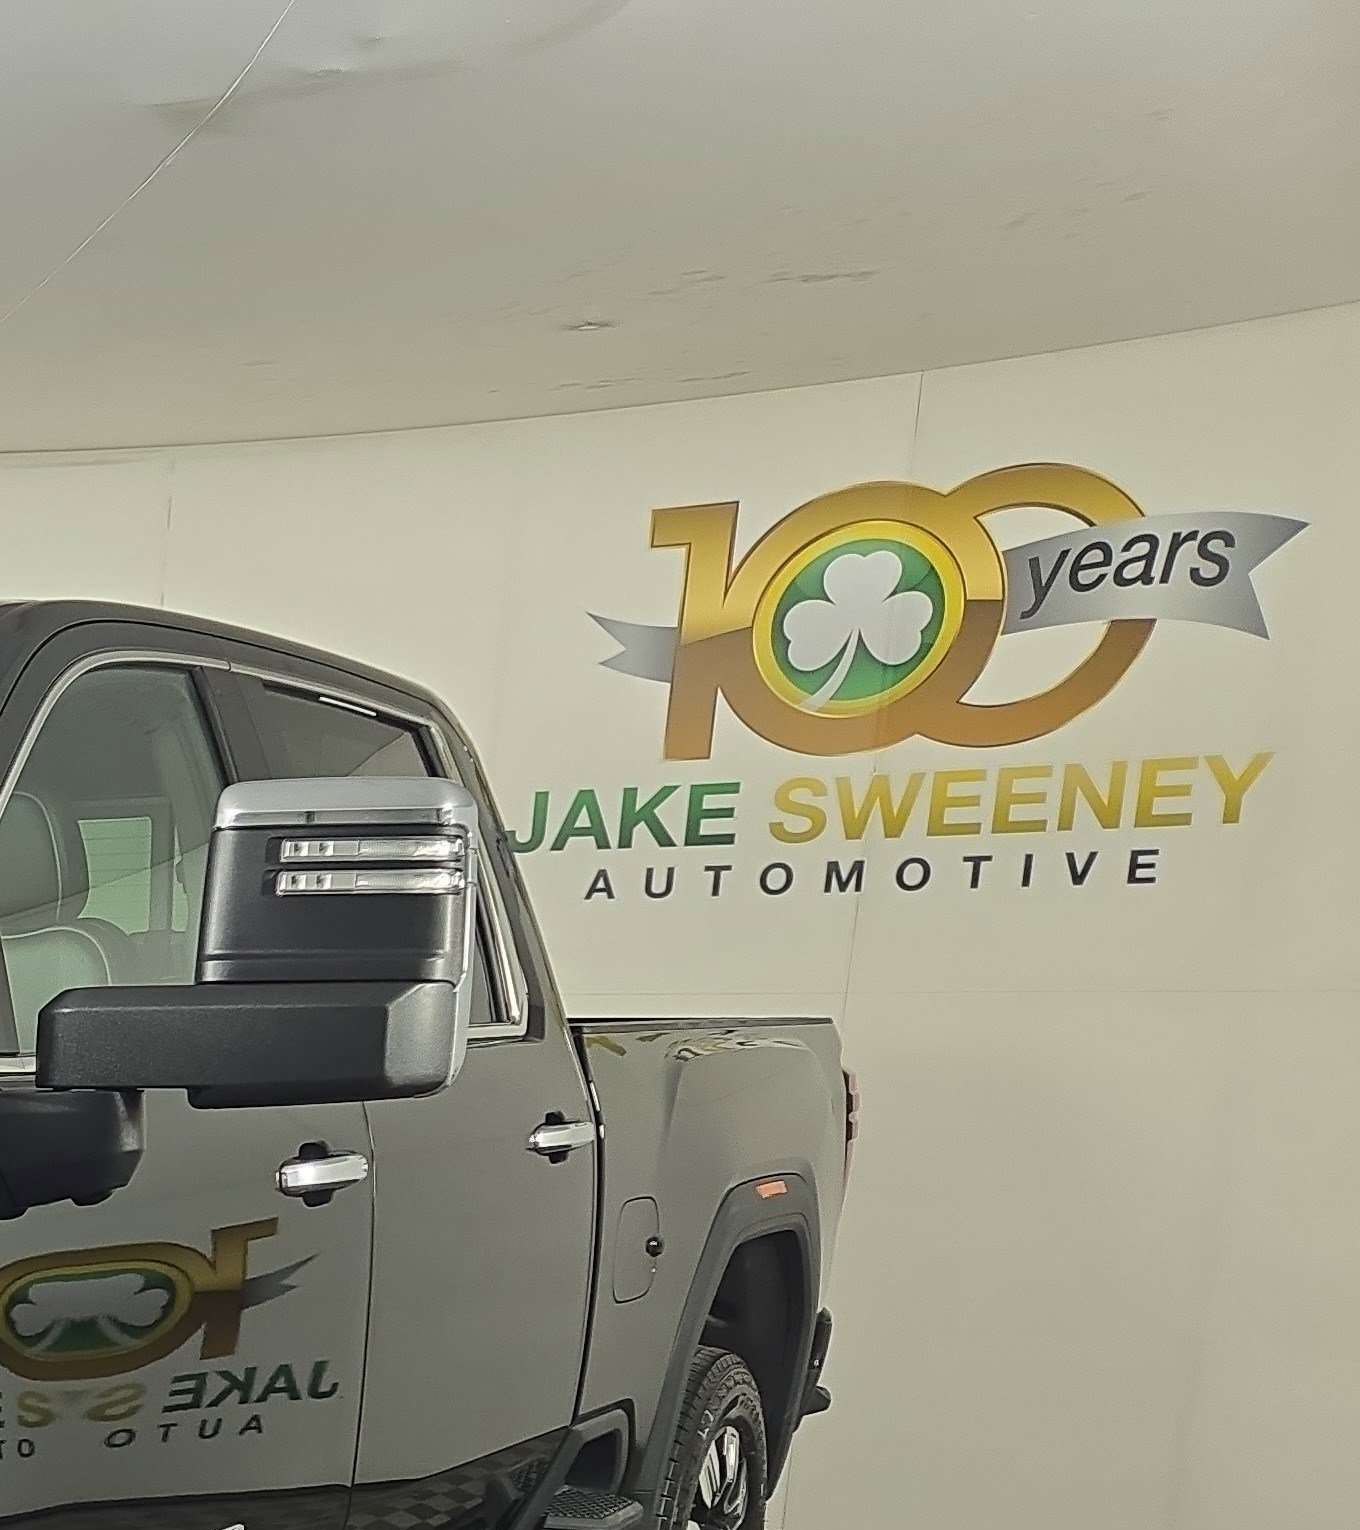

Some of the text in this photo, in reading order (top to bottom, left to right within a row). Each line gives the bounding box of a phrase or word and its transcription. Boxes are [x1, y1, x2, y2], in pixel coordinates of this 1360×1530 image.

[1019, 528, 1235, 619] years
[504, 751, 1275, 853] JAKE SWEENEY
[584, 849, 1161, 901] AUTOMOTIVE
